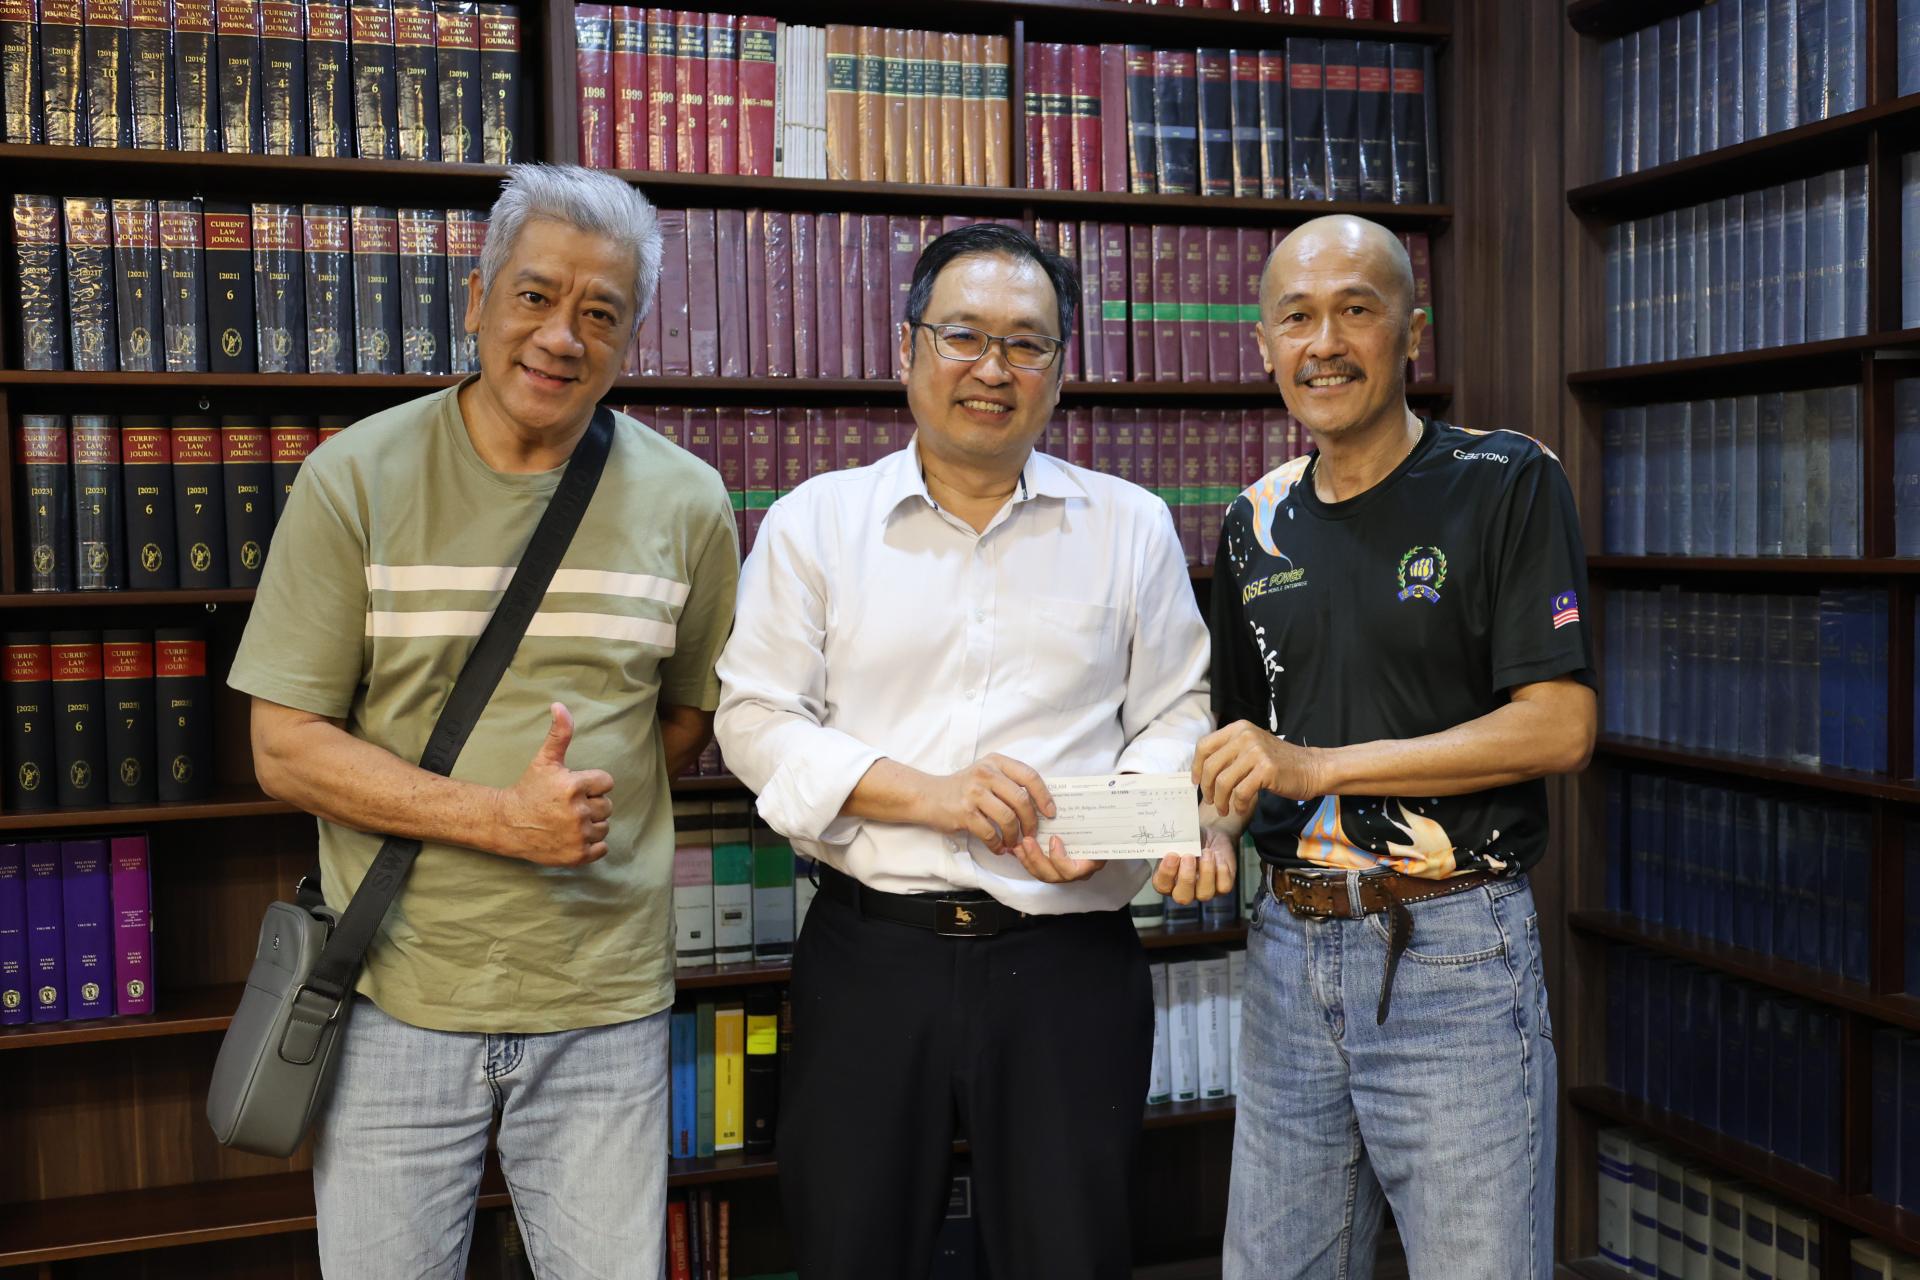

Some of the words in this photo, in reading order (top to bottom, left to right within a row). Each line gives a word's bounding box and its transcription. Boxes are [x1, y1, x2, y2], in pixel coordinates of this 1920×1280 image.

[264, 9, 297, 18] CURRENT
[265, 25, 297, 33] JOURNAL
[12, 64, 20, 73] 8
[59, 66, 67, 75] 9
[102, 69, 115, 78] 10
[149, 71, 155, 80] 1
[192, 74, 199, 84] 2
[236, 76, 243, 85] 3
[278, 79, 285, 87] 4
[326, 81, 333, 90] 5
[372, 84, 378, 93] 6
[414, 85, 421, 94] 7
[456, 88, 463, 97] 8
[499, 89, 505, 98] 9
[583, 87, 605, 99] 1998
[621, 89, 643, 100] 1999
[653, 92, 673, 104] 1999
[681, 94, 702, 105] 1999
[713, 94, 734, 105] 1999
[630, 113, 635, 123] 1
[660, 116, 667, 125] 2
[689, 117, 695, 127] 3
[721, 119, 727, 128] 4
[210, 221, 244, 229] CURRENT
[211, 235, 244, 244] JOURNAL
[127, 271, 148, 279] [2021]
[219, 272, 240, 281] [2021]
[135, 288, 142, 298] 4
[181, 288, 187, 298] 5
[227, 289, 233, 299] 6
[277, 291, 283, 300] 7
[326, 292, 332, 301] 8
[375, 293, 381, 303] 9
[420, 294, 432, 304] 10
[229, 434, 263, 442] CURRENT
[129, 450, 162, 458] JOURNAL
[179, 450, 212, 458] JOURNAL
[230, 449, 263, 457] JOURNAL
[31, 487, 52, 496] [2023]
[85, 487, 106, 495] [2023]
[138, 486, 159, 495] [2023]
[187, 486, 208, 495] [2023]
[39, 505, 46, 516] 4
[93, 504, 100, 515] 5
[146, 504, 153, 515] 6
[195, 504, 202, 515] 7
[245, 503, 253, 513] 8
[1269, 568, 1304, 587] POWER
[126, 719, 133, 729] 7
[178, 717, 185, 726] 8
[24, 723, 31, 733] 5
[75, 721, 83, 732] 6
